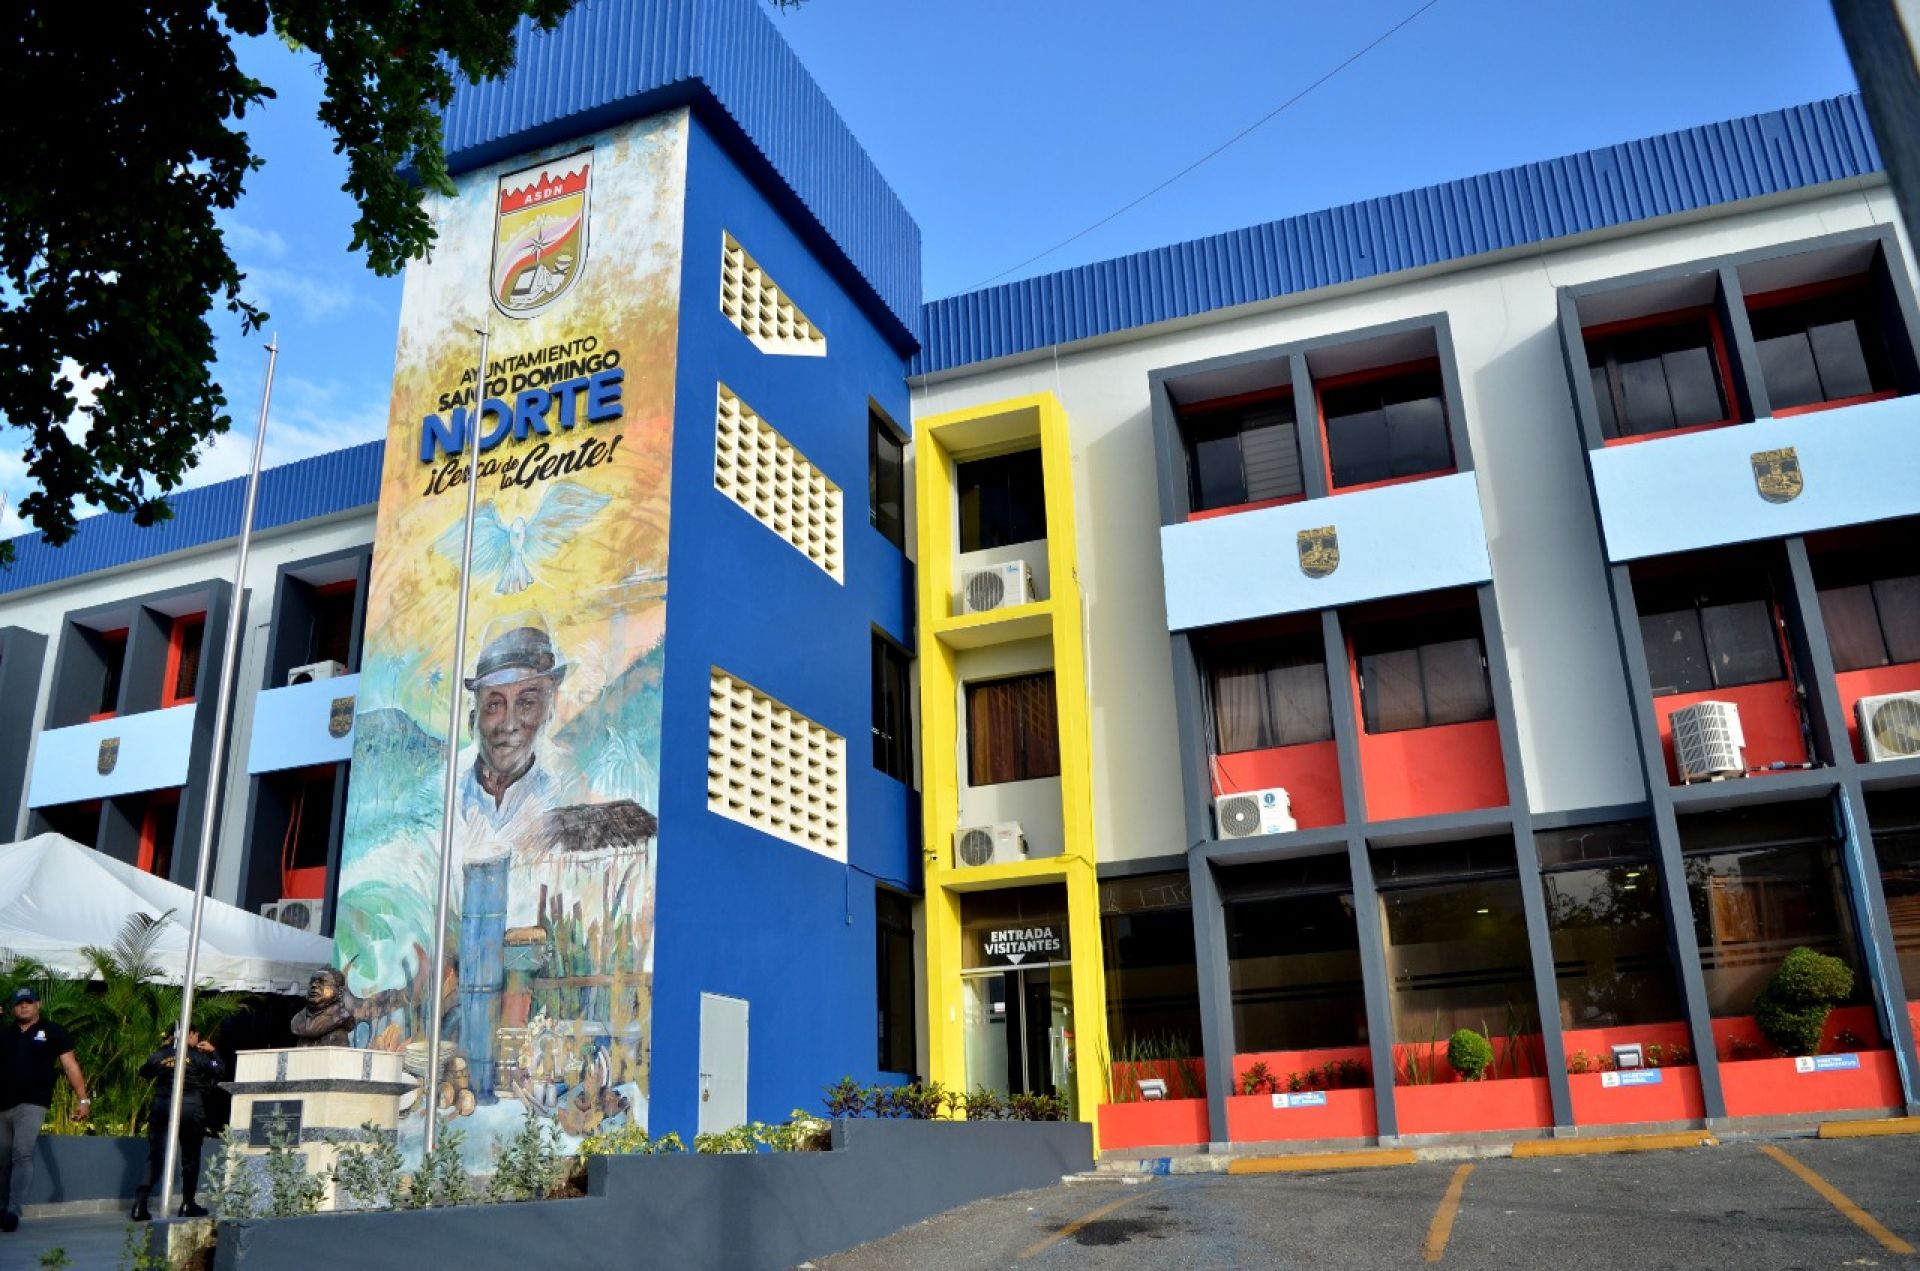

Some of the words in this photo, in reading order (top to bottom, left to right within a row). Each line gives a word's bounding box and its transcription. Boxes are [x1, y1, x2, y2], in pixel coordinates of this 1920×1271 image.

[524, 184, 563, 205] ASDN
[460, 335, 598, 387] AYUNTAMIENTO
[438, 377, 508, 412] SANTO
[511, 349, 621, 394] DOMINGO
[419, 367, 625, 465] NORTE
[501, 455, 519, 474] de
[514, 434, 624, 489] Gente!
[500, 473, 514, 491] la
[991, 926, 1054, 943] ENTRADA
[984, 938, 1060, 956] VISITANTES
